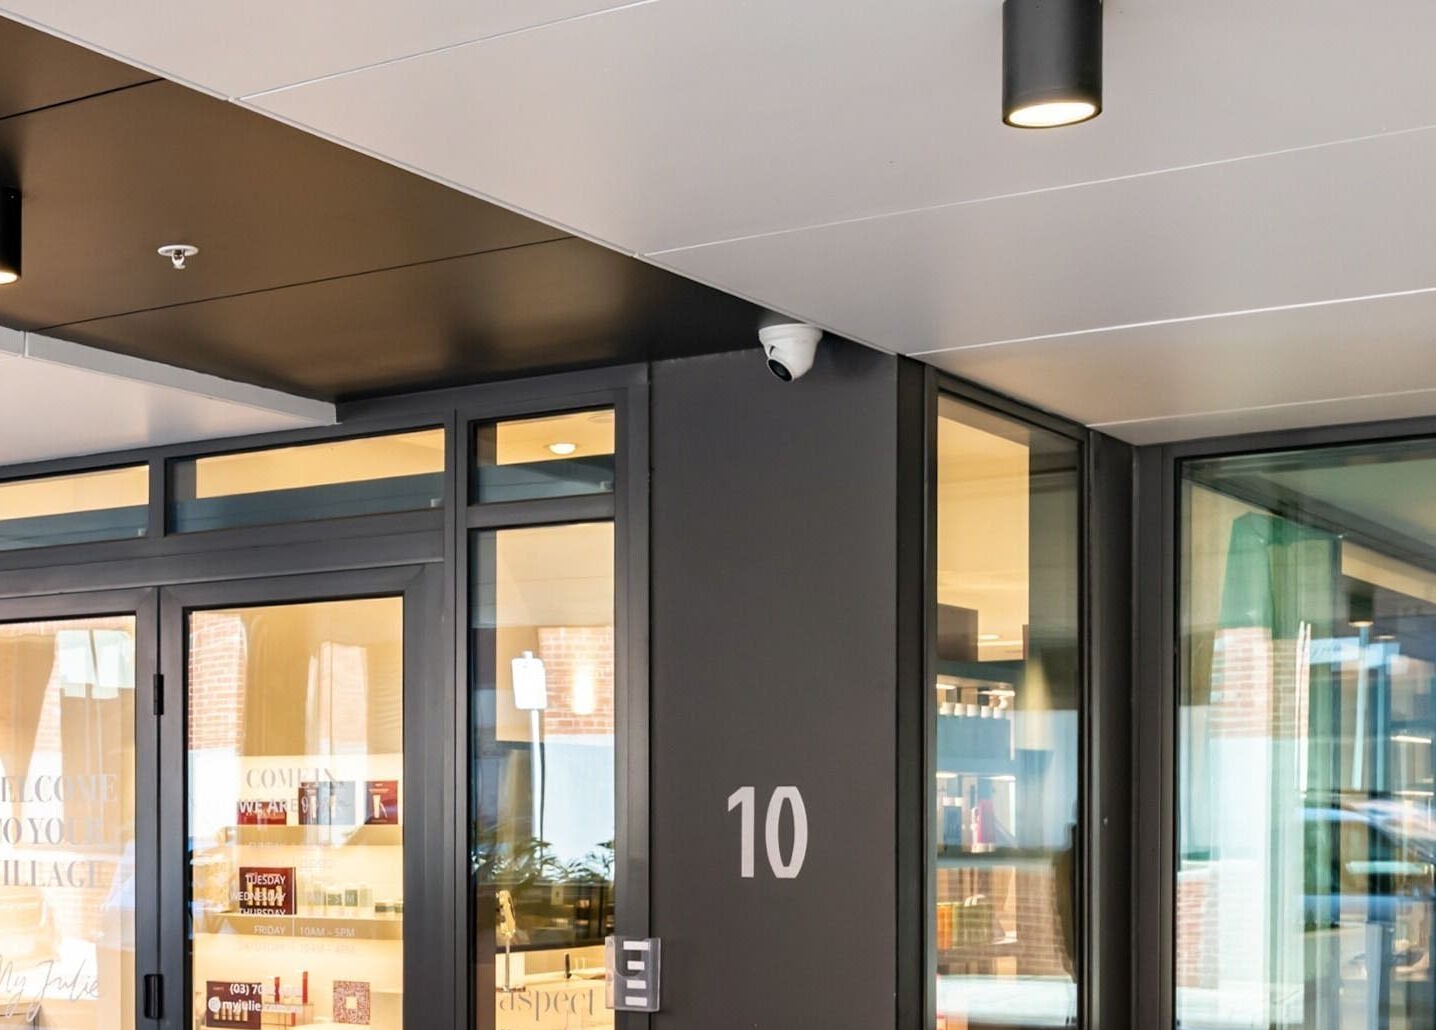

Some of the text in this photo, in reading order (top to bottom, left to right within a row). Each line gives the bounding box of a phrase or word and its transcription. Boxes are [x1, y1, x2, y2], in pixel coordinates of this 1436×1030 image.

[246, 768, 313, 789] COME
[240, 801, 264, 814] WE
[267, 800, 299, 814] ARE
[27, 816, 107, 846] YOUR
[727, 785, 809, 879] 10
[245, 874, 286, 885] TUESDAY
[231, 892, 286, 902] WEDNESDAY
[239, 908, 286, 917] THURSDAY
[254, 925, 286, 936] FRIDAY
[300, 926, 325, 937] 10AM
[334, 927, 356, 938] 5PM
[27, 959, 101, 1023] Julie
[229, 983, 250, 996] (03)
[499, 988, 594, 1021] aspect
